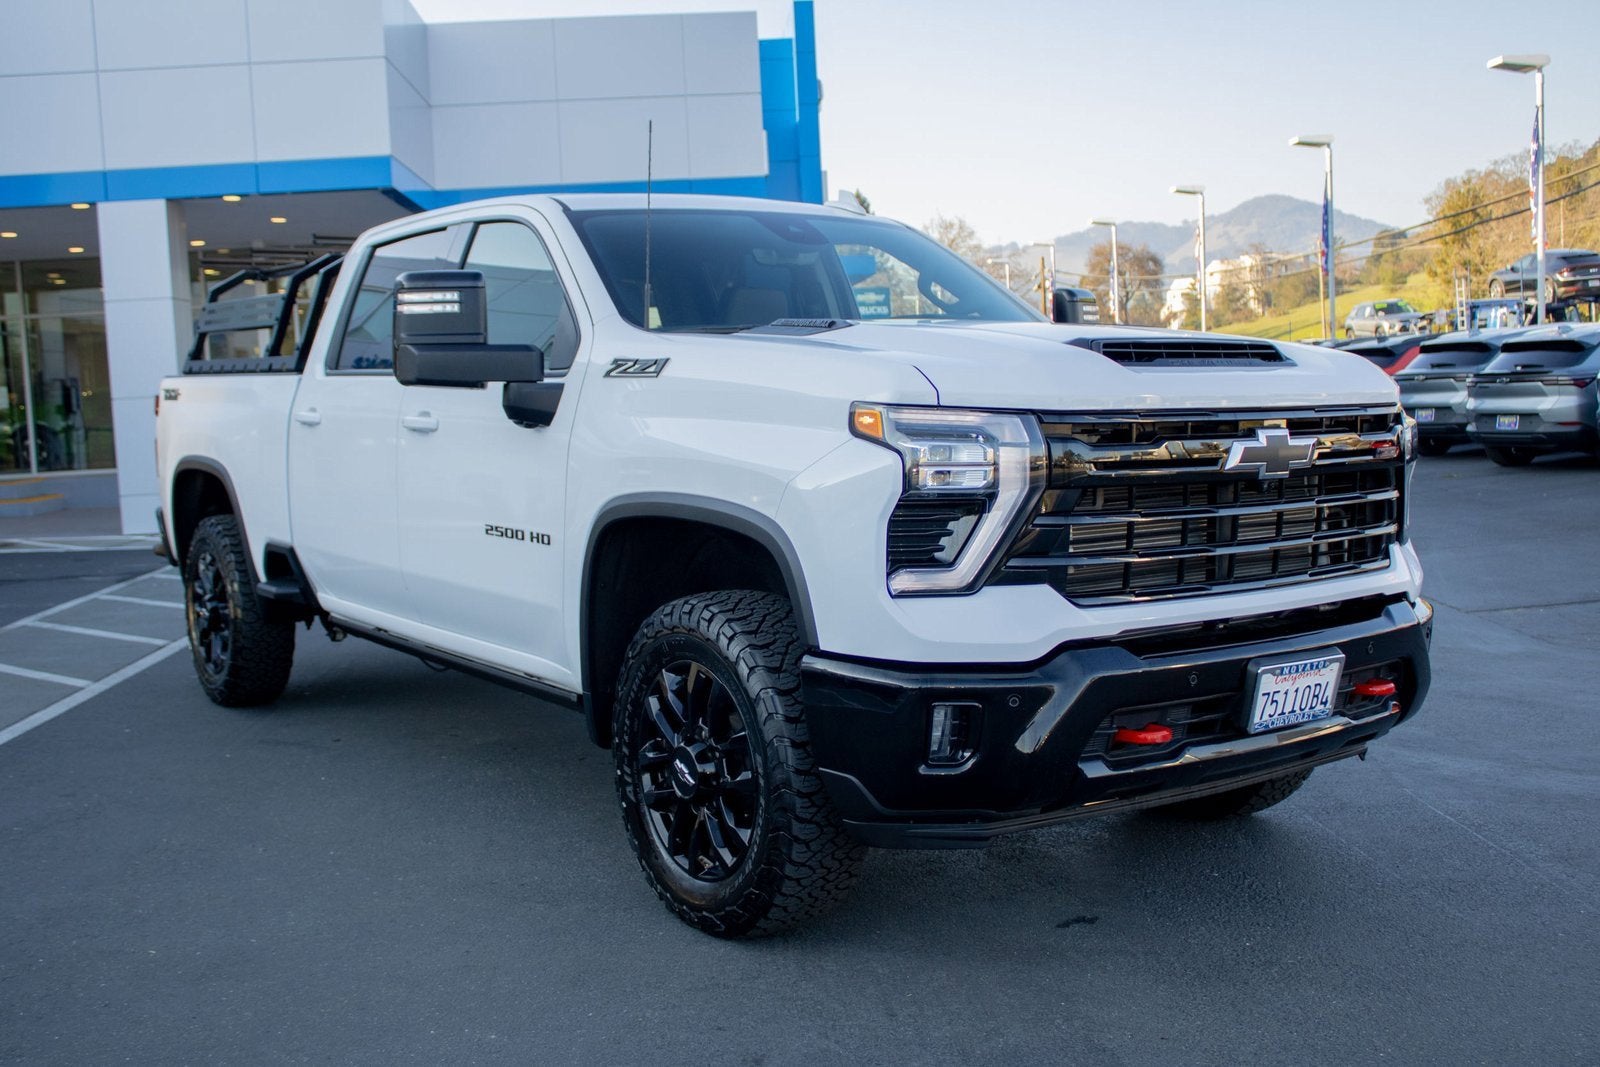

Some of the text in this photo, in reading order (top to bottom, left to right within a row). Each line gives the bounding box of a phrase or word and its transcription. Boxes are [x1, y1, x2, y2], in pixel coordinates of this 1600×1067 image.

[603, 357, 670, 378] Z71
[485, 524, 551, 546] 2500 HD
[1282, 660, 1327, 675] NOVATO
[1274, 669, 1326, 686] California
[1260, 681, 1330, 721] 75110B4
[1268, 712, 1314, 728] CHEVROLET
